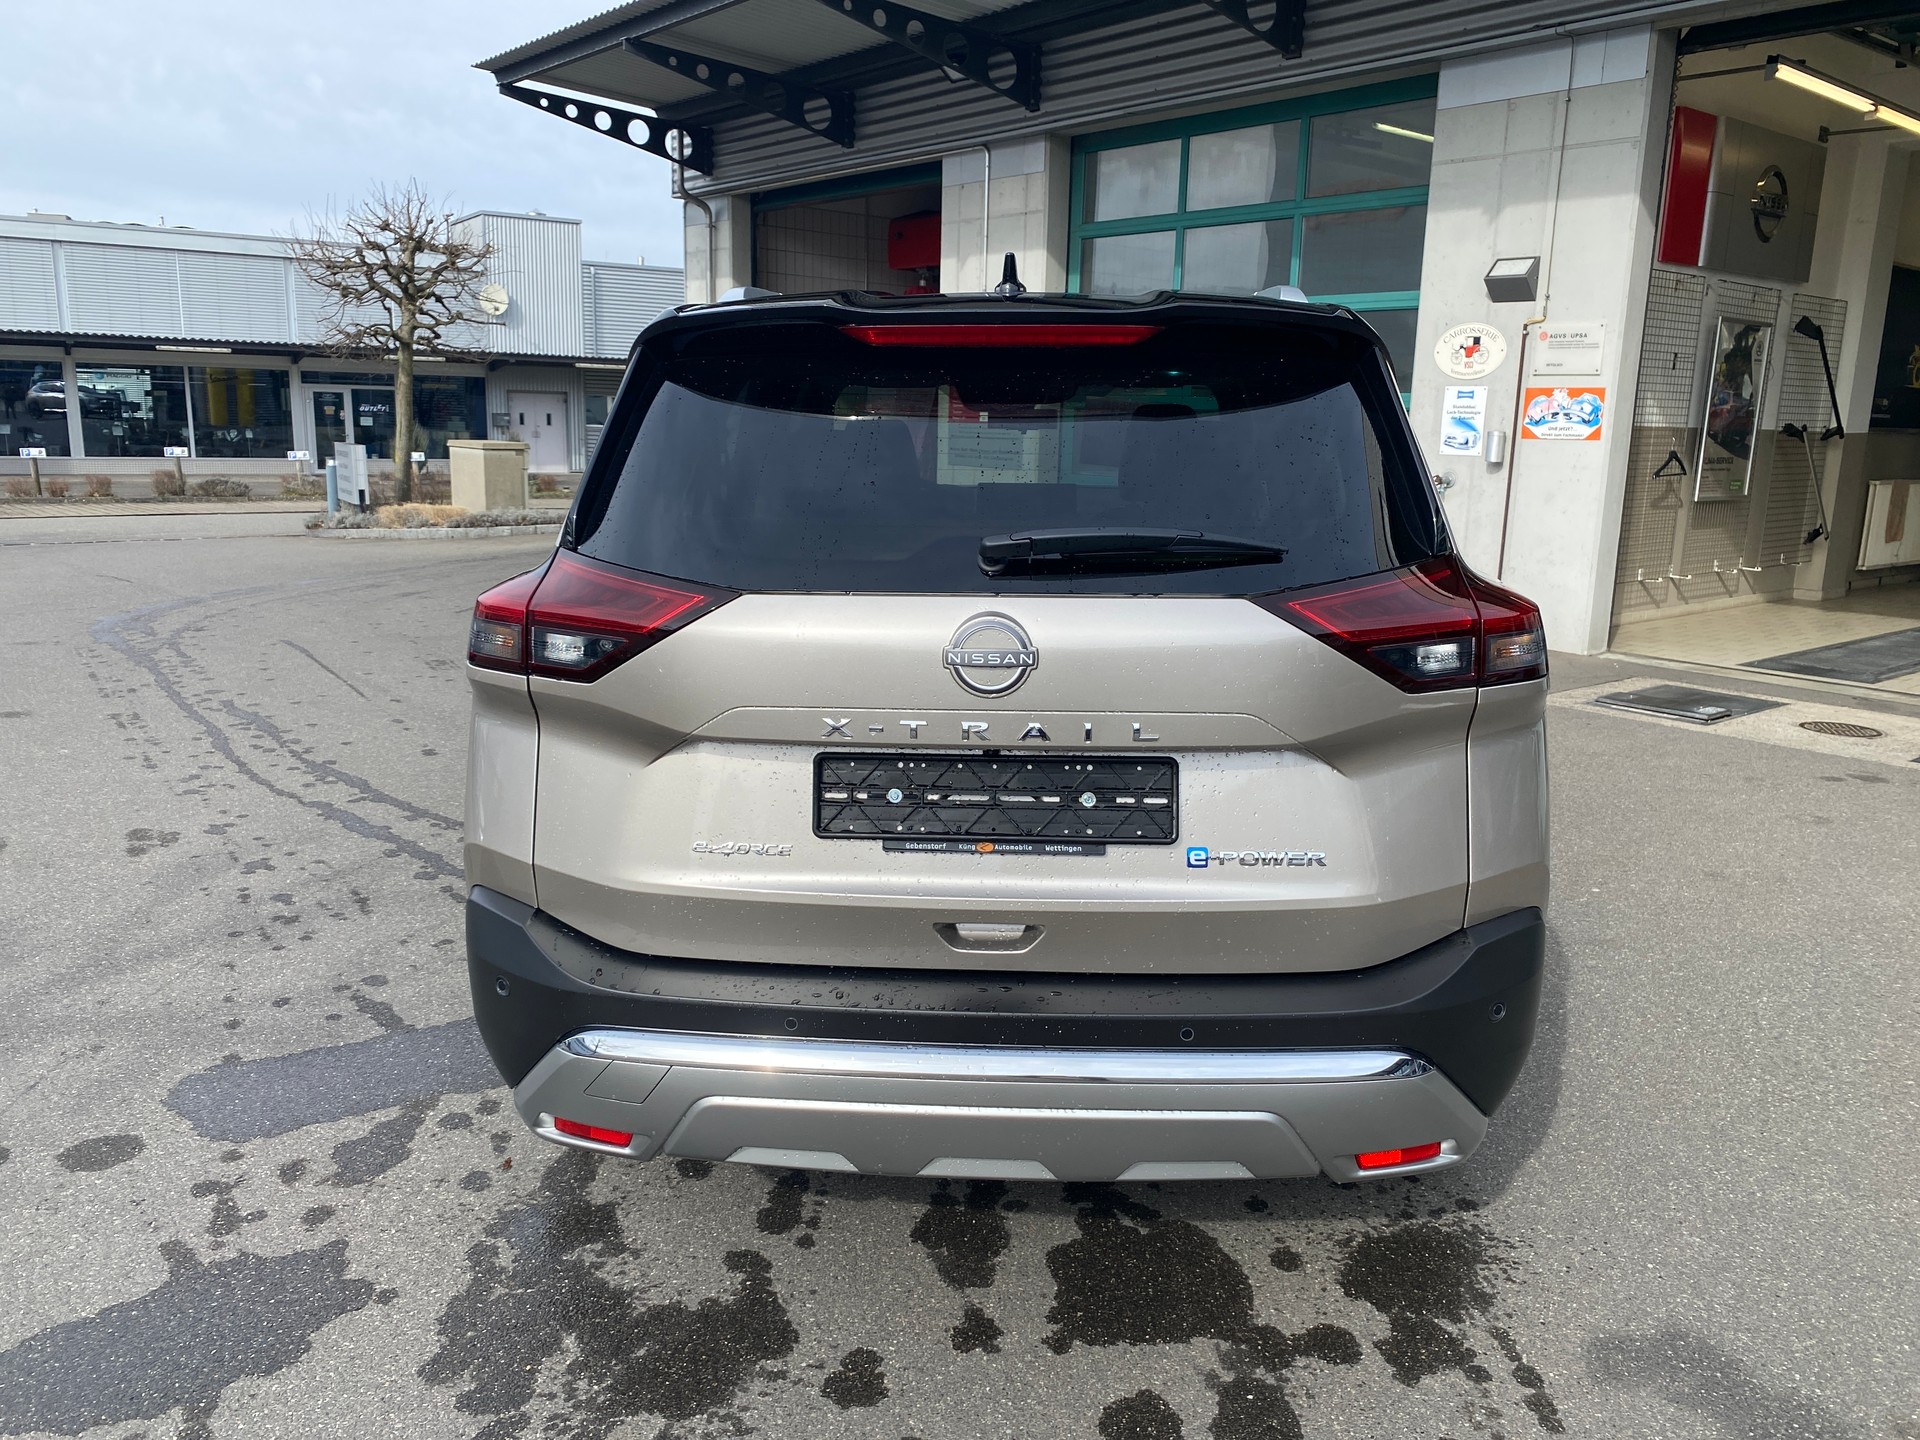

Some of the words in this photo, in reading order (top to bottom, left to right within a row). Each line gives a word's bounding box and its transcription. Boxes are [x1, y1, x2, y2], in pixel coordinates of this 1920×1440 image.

[1443, 326, 1500, 344] CARROSSERIE
[359, 404, 386, 412] OUTLET
[947, 652, 1034, 665] NISSAN
[820, 717, 1160, 742] X-TRAIL
[905, 842, 947, 850] Gebenstorf
[1045, 844, 1082, 853] Wettingen
[1187, 847, 1328, 868] e-POWER
